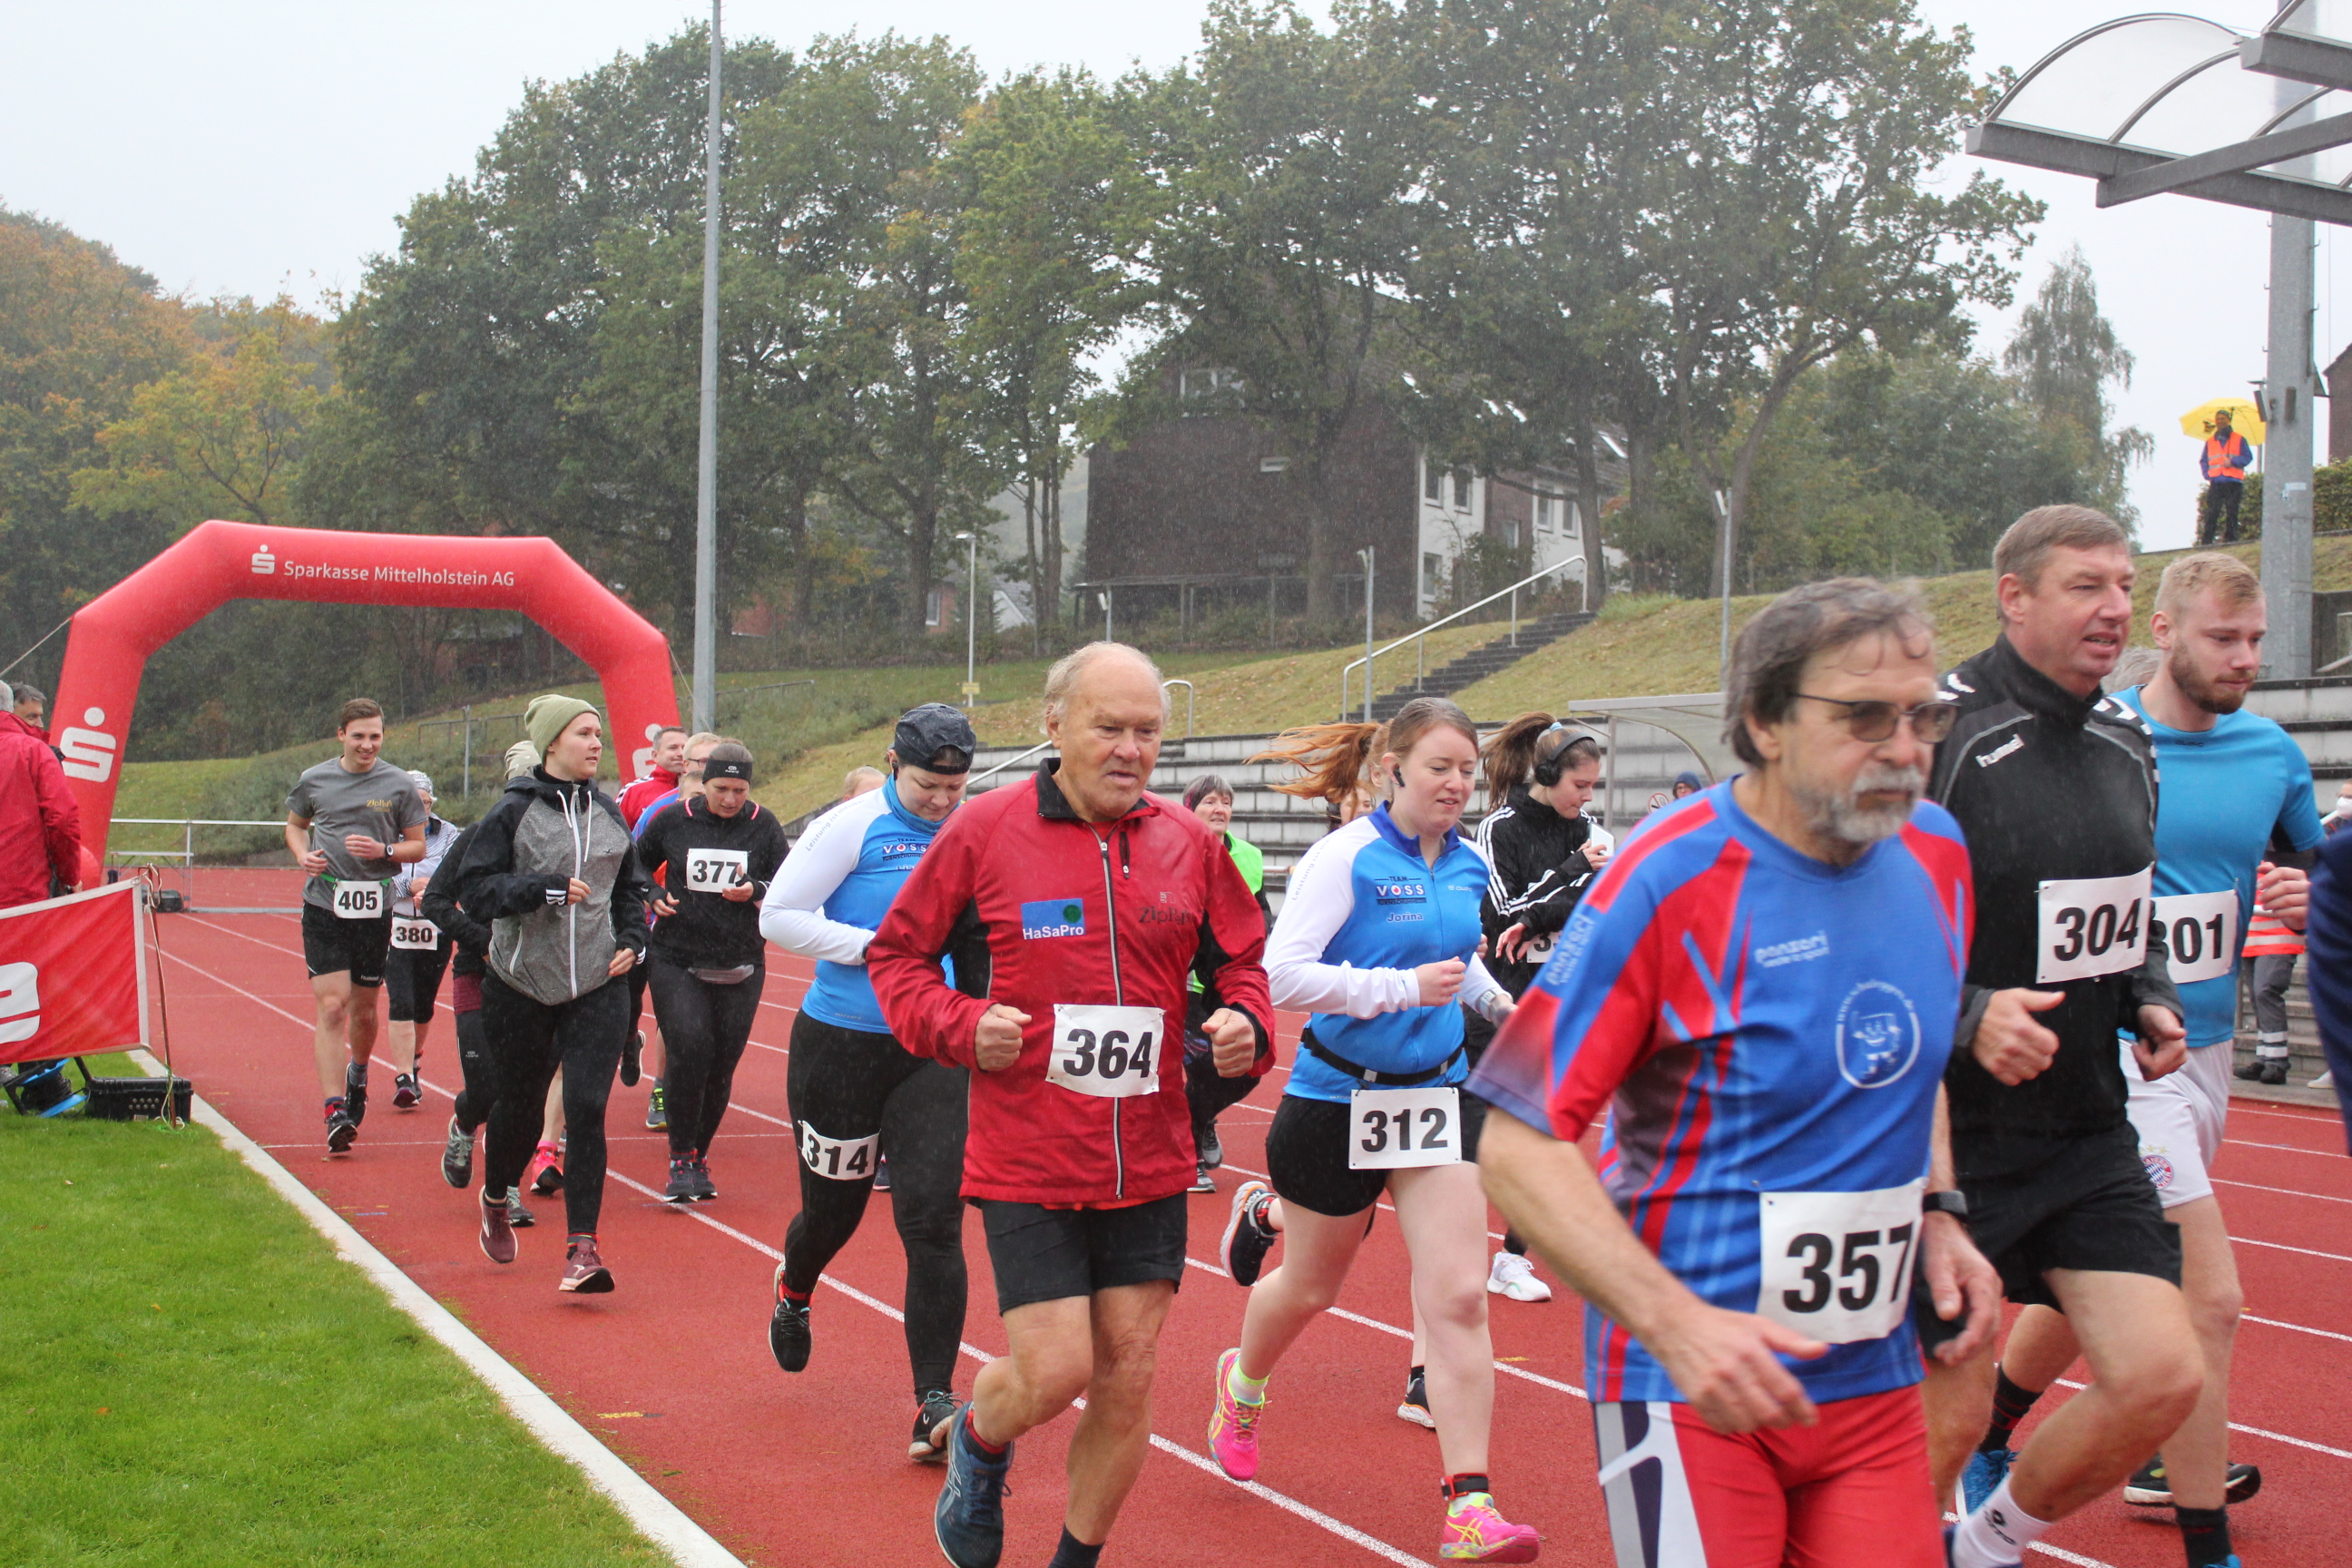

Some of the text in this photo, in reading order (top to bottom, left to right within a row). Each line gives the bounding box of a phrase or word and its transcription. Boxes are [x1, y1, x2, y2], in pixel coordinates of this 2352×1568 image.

[283, 561, 515, 587] Sparkasse Mittelholstein AG
[805, 821, 831, 852] Leistung
[882, 843, 927, 854] VOSS
[692, 859, 741, 885] 377
[1388, 875, 1408, 883] TEAM
[338, 890, 377, 911] 405
[1376, 883, 1425, 897] VOSS
[1387, 911, 1425, 923] Jorina
[2053, 897, 2142, 962] 304
[396, 926, 433, 943] 380
[1022, 924, 1084, 940] HaSaPro
[1063, 1028, 1153, 1080] 364
[1361, 1107, 1448, 1153] 312
[806, 1132, 869, 1176] 314
[1783, 1221, 1915, 1314] 357
